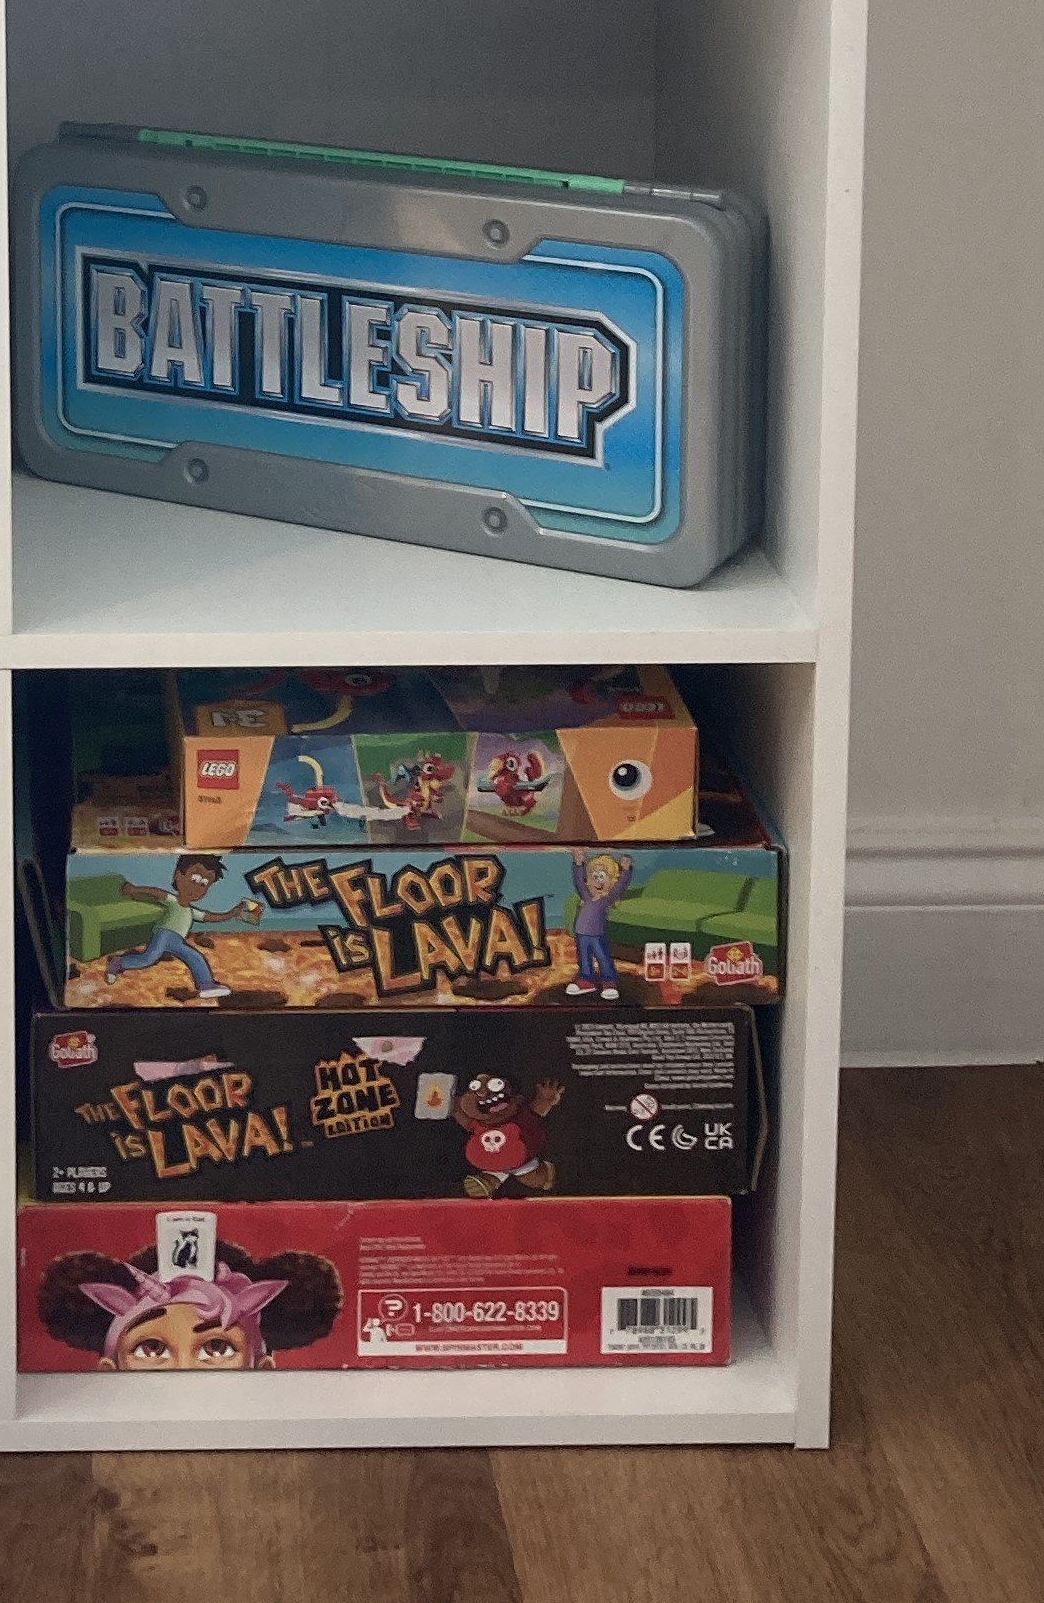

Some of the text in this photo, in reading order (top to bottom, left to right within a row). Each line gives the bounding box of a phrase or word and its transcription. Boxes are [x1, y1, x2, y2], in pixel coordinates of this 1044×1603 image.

[89, 265, 620, 447] BATTLESHIP
[201, 762, 236, 777] LEGO
[253, 858, 501, 928] THE FLOOR
[372, 903, 547, 992] LAVA!
[707, 956, 761, 975] Goliath
[318, 1058, 380, 1092] HOT
[74, 1072, 253, 1130] THE FLOOR
[315, 1083, 396, 1122] ZONE
[148, 1105, 295, 1179] LAVA!
[705, 1122, 733, 1136] UK
[705, 1136, 734, 1150] CA
[413, 1300, 560, 1323] 1-800-622-8339
